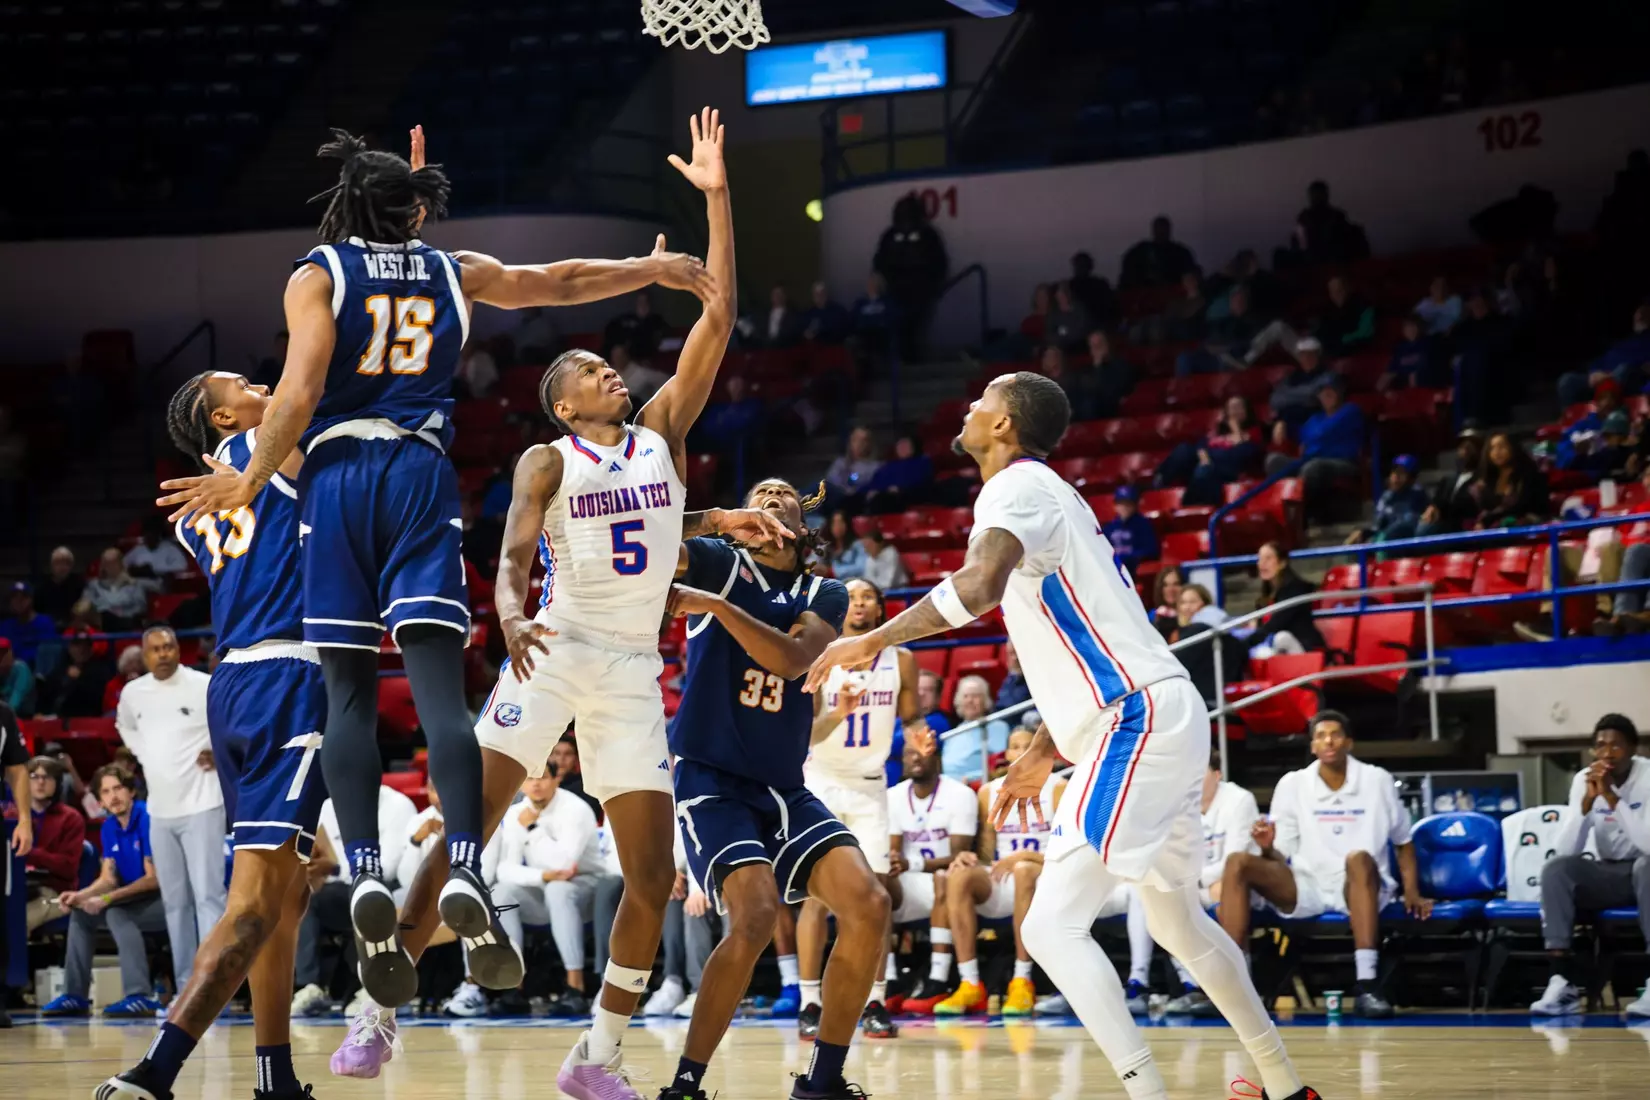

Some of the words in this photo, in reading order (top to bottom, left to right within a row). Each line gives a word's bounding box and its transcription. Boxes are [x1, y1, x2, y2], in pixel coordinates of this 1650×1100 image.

[1477, 111, 1542, 152] 102
[362, 253, 404, 280] WEST
[406, 254, 431, 280] JR.
[356, 294, 435, 376] 15
[568, 487, 641, 519] LOUISIANA
[609, 519, 648, 576] 5
[739, 668, 784, 713] 33
[844, 712, 870, 747] 11
